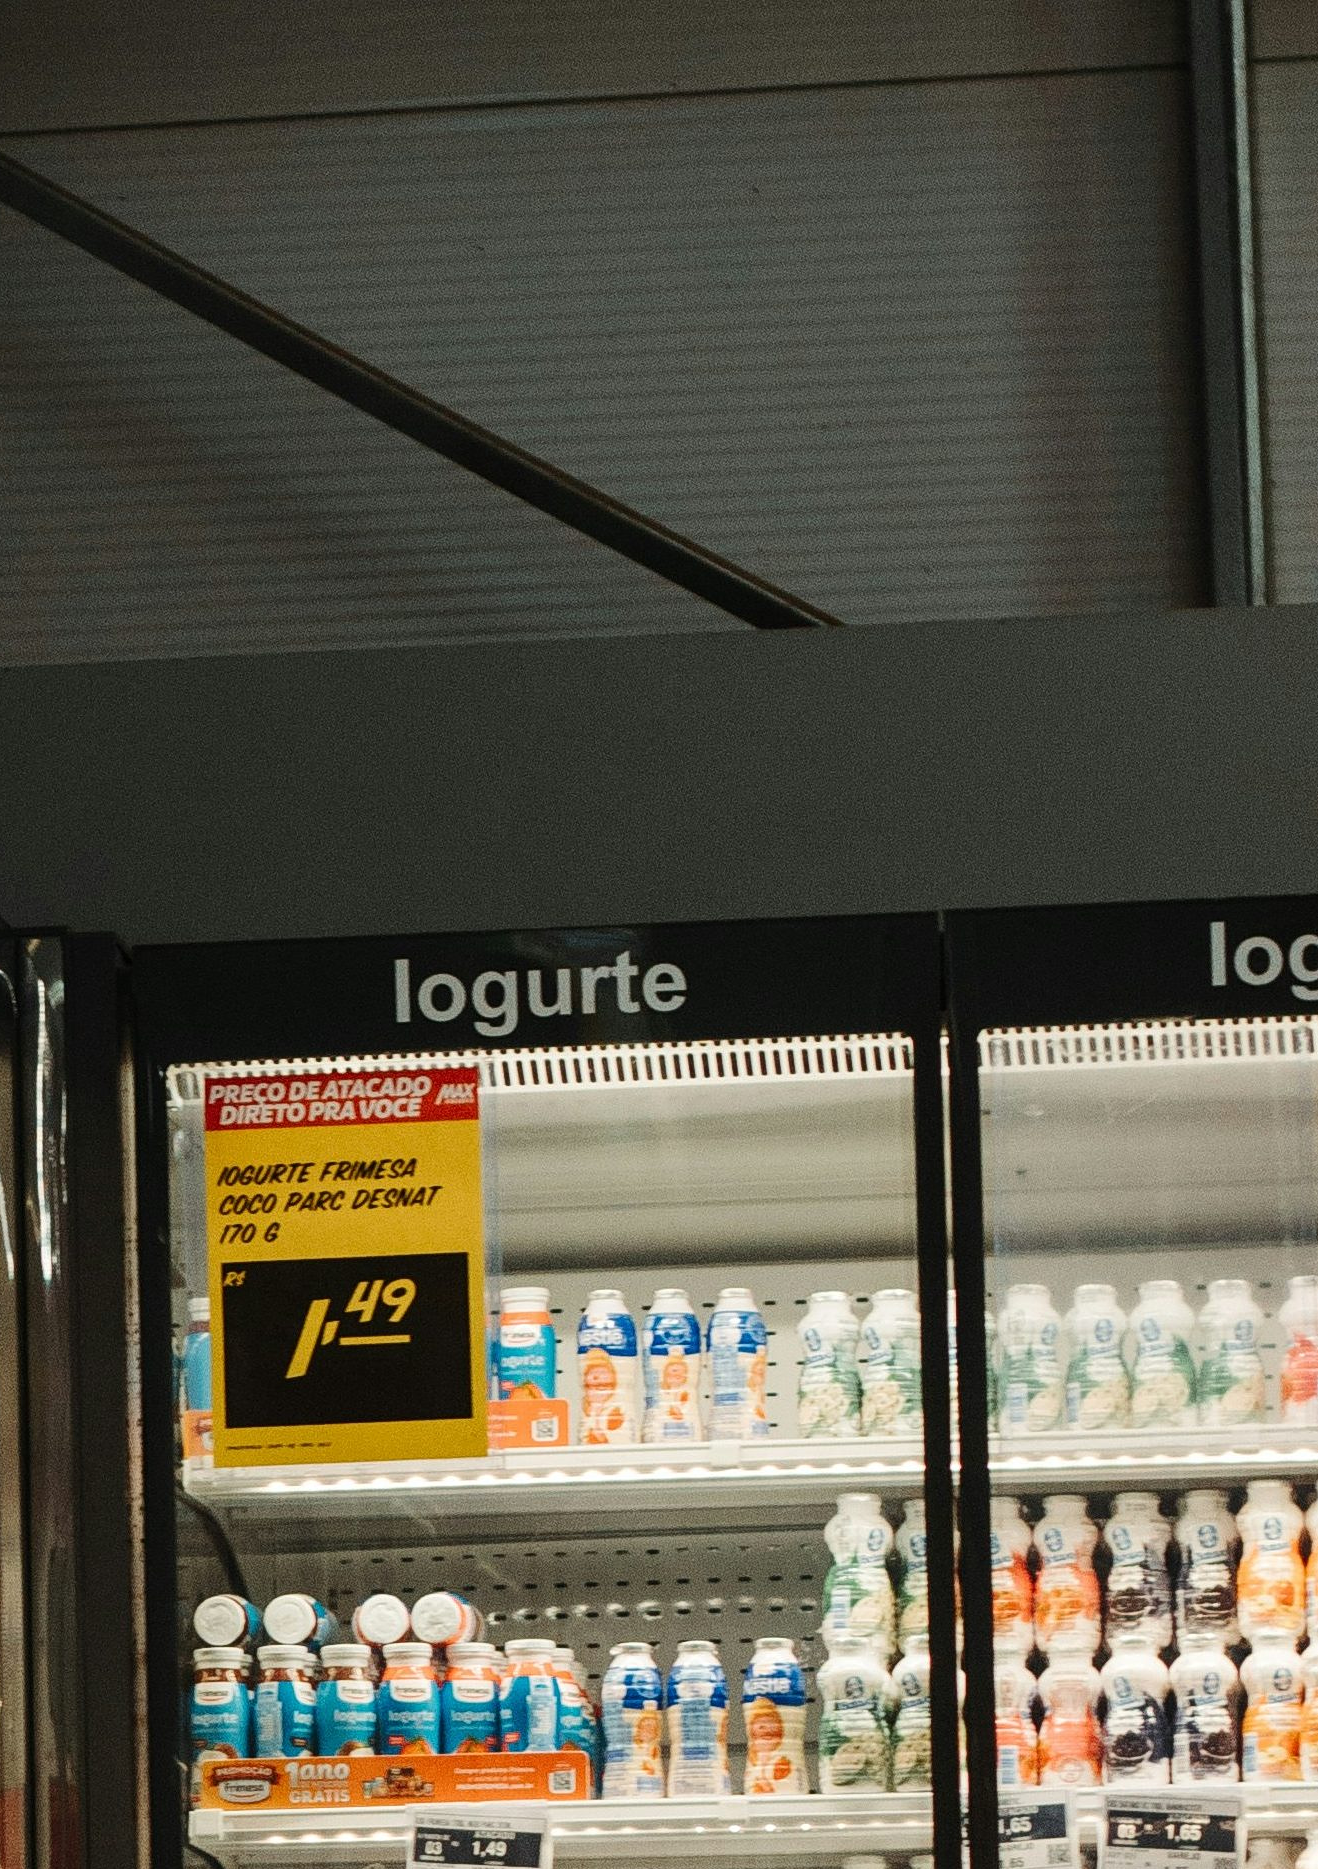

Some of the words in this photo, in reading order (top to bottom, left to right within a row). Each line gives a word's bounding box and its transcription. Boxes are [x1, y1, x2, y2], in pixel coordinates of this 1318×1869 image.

[395, 948, 688, 1038] Iogurte
[208, 1081, 287, 1107] PREÇO
[288, 1079, 322, 1101] DE
[321, 1076, 432, 1100] ATACADO
[219, 1103, 306, 1126] DIRETO
[307, 1101, 358, 1122] PRA
[216, 1162, 315, 1187] IOGURTE
[319, 1158, 417, 1182] FRIMESA
[218, 1193, 278, 1216] COCO
[283, 1190, 346, 1213] PARC
[351, 1185, 443, 1210] DESNAT
[219, 1223, 258, 1244] 170
[264, 1222, 281, 1243] G
[285, 1277, 417, 1380] 1,49
[1164, 1823, 1203, 1842] 1,65
[471, 1839, 508, 1858] 1,49
